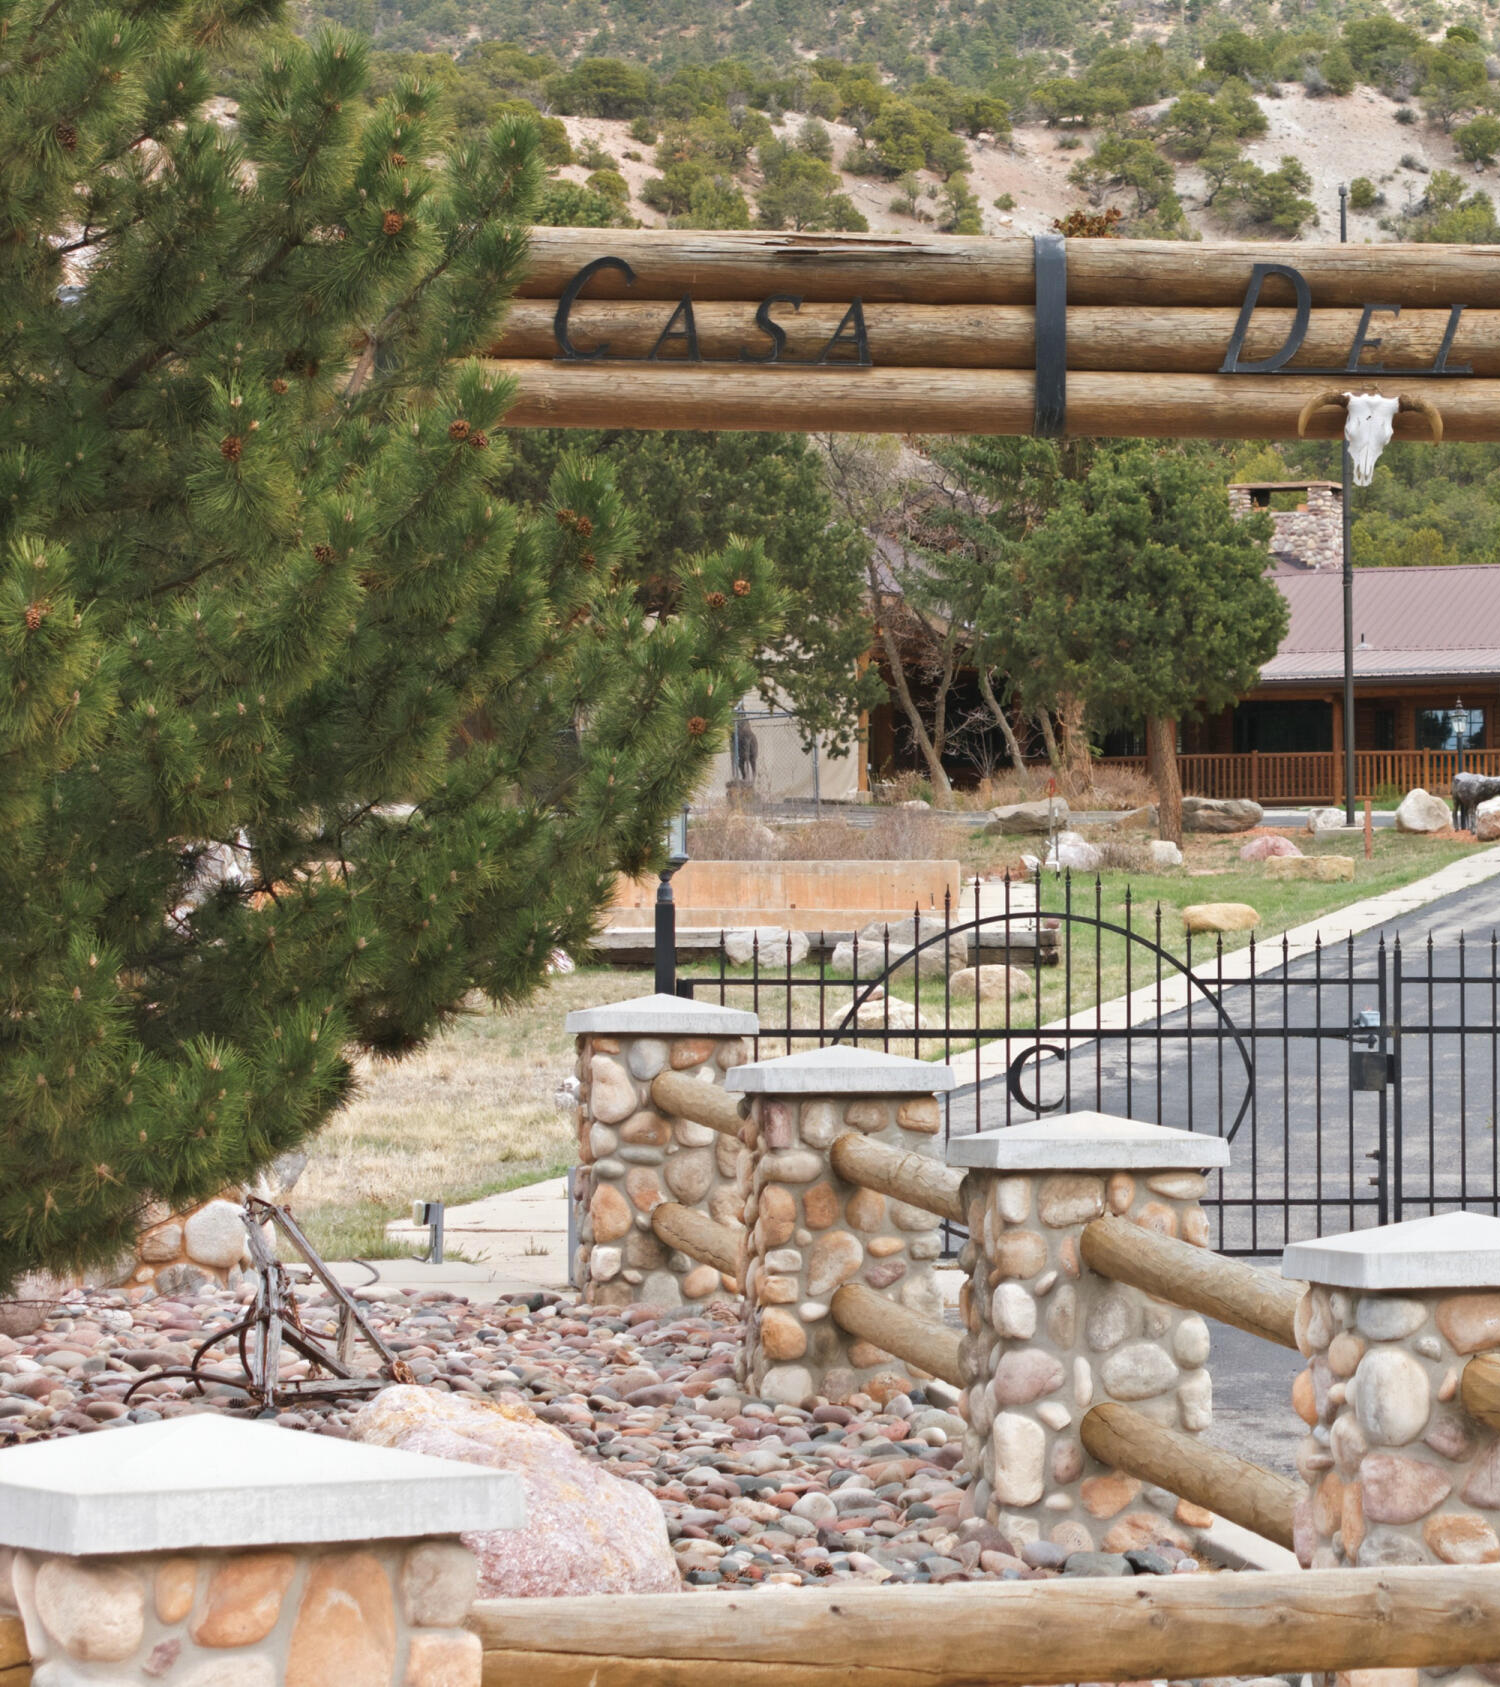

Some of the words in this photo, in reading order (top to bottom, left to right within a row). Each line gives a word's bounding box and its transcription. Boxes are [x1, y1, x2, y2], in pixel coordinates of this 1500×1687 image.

[554, 256, 872, 365] CASA
[1218, 263, 1473, 374] DEL
[1007, 1043, 1065, 1113] C
